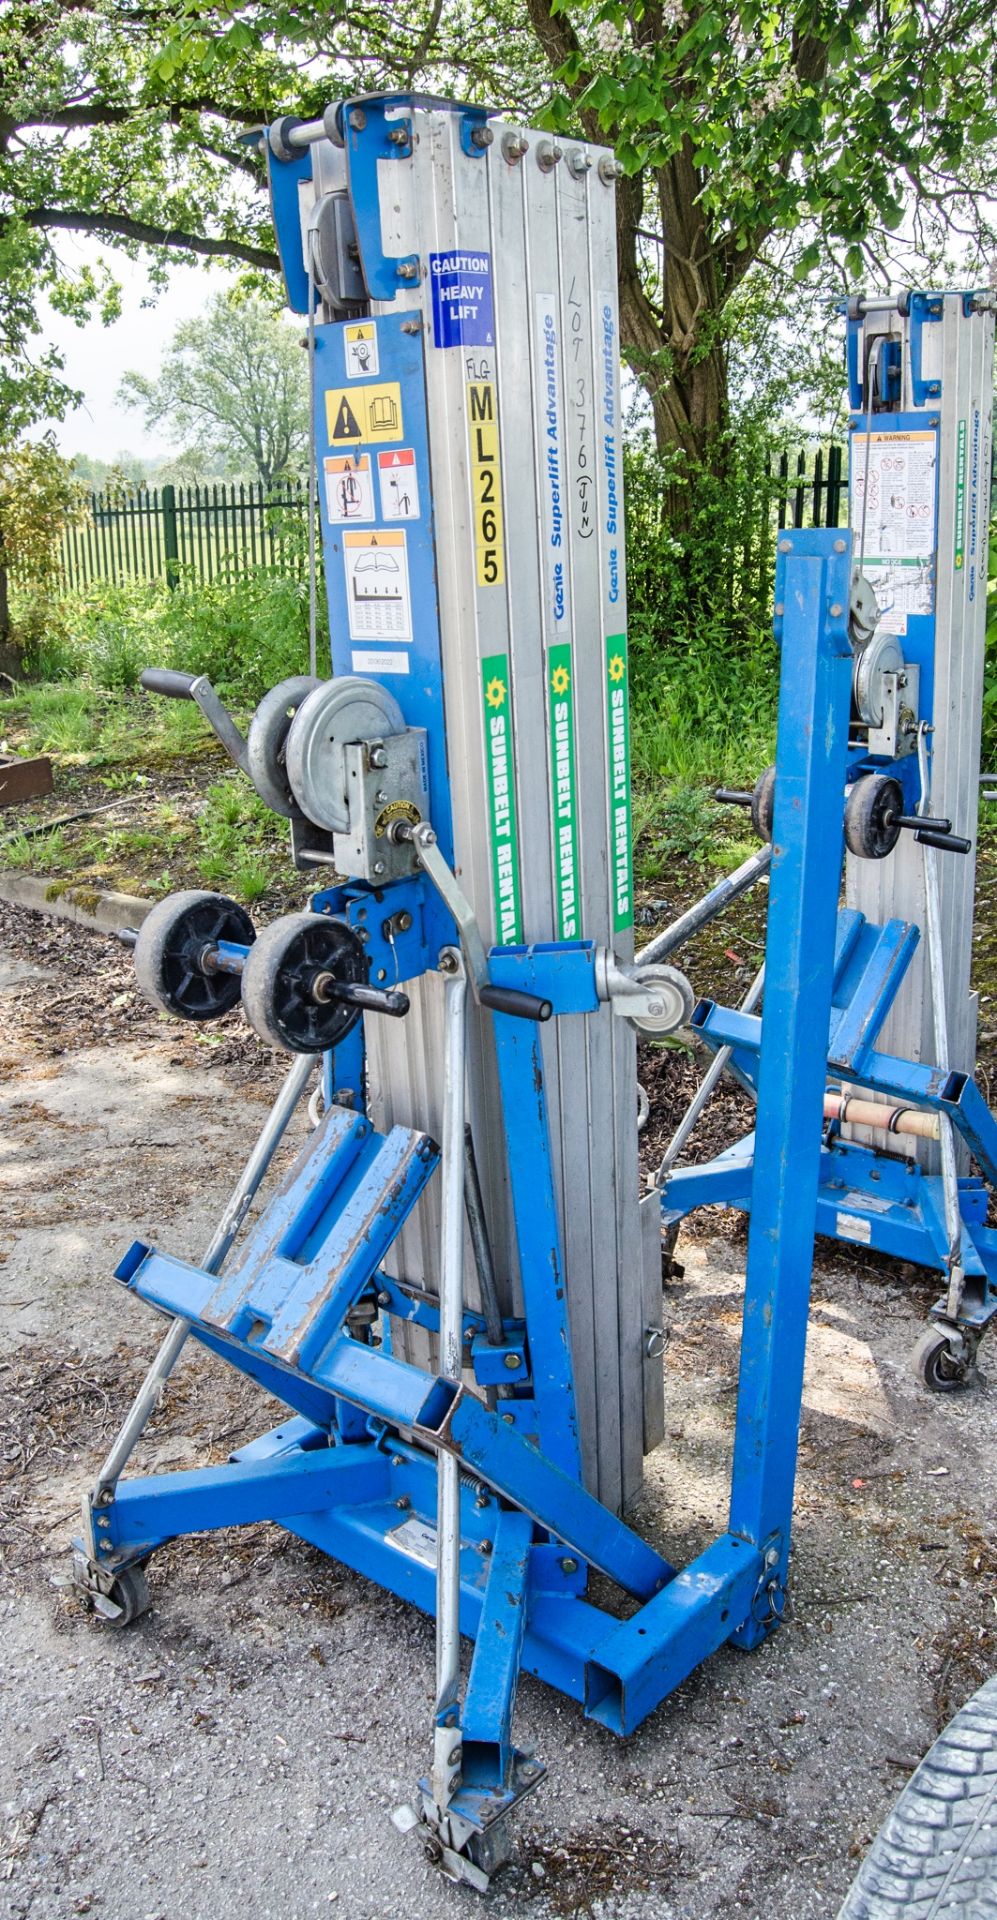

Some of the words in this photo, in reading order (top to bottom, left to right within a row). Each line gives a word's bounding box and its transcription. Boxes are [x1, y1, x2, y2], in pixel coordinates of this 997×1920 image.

[432, 257, 488, 273] CAUTION
[440, 286, 484, 301] HEAVY
[450, 305, 478, 320] LIFT
[466, 359, 491, 380] FLG
[567, 276, 584, 362] LOT
[601, 305, 615, 427] Advantage
[543, 314, 558, 442] Advantage
[471, 386, 499, 583] ML265
[603, 434, 618, 535] Superlift
[884, 434, 910, 442] WARNING
[546, 447, 563, 548] Superlift
[552, 563, 565, 621] Genie
[608, 549, 620, 604] Genie
[489, 714, 510, 836] SUNBELT
[554, 702, 572, 819] SUNBELT
[611, 688, 627, 800] SUNBELT
[386, 802, 410, 813] CAUTION
[558, 825, 576, 939] RENTALS
[614, 807, 629, 915] RENTALS
